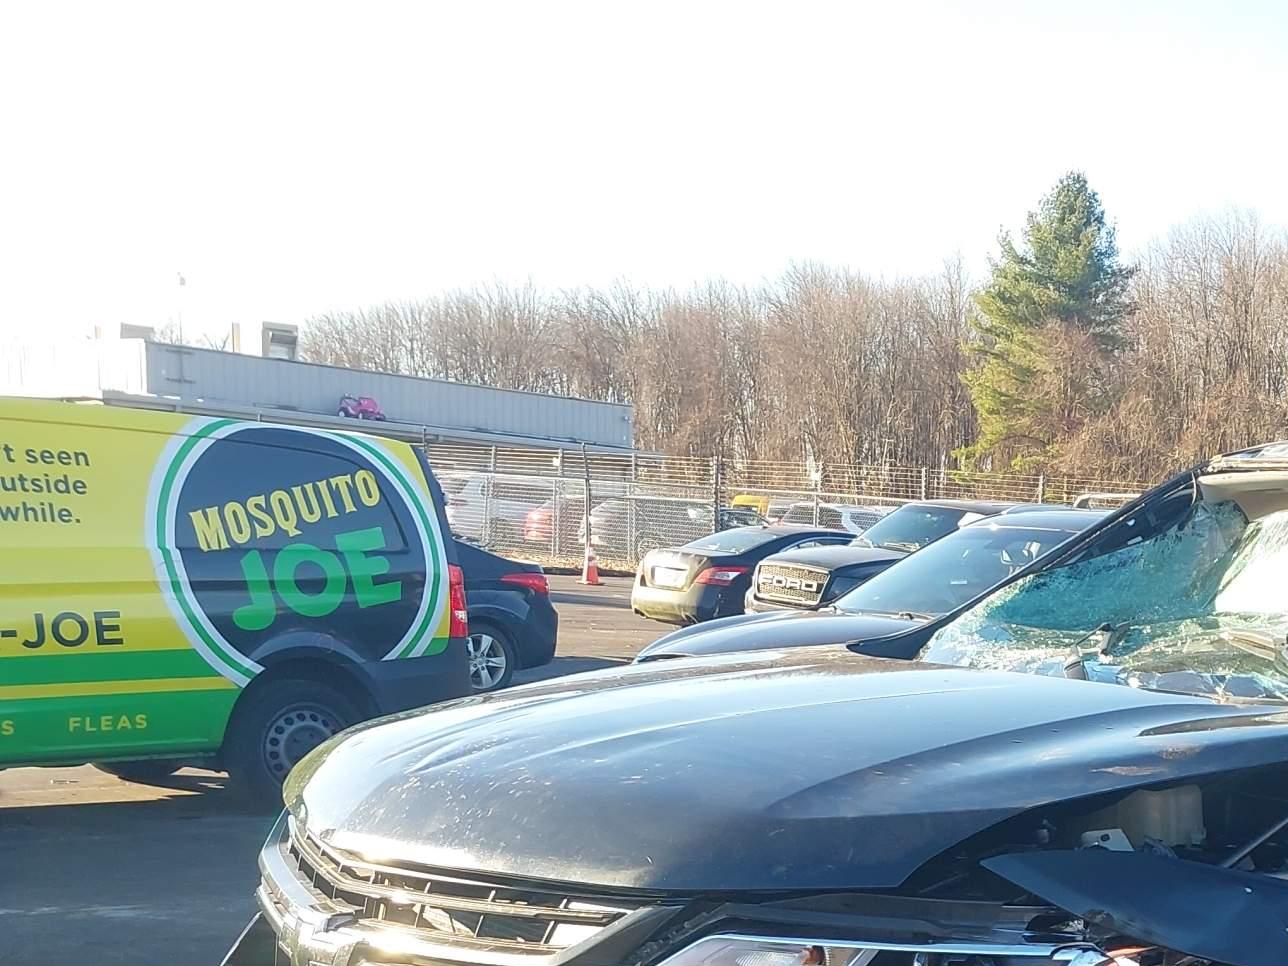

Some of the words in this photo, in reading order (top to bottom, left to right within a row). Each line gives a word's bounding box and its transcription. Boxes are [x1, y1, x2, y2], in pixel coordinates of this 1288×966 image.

[25, 449, 90, 467] seen
[0, 501, 81, 523] while.
[189, 469, 381, 552] MOSQUITO
[232, 526, 402, 631] JOE
[759, 574, 818, 592] FORD
[68, 714, 148, 732] FLEAS
